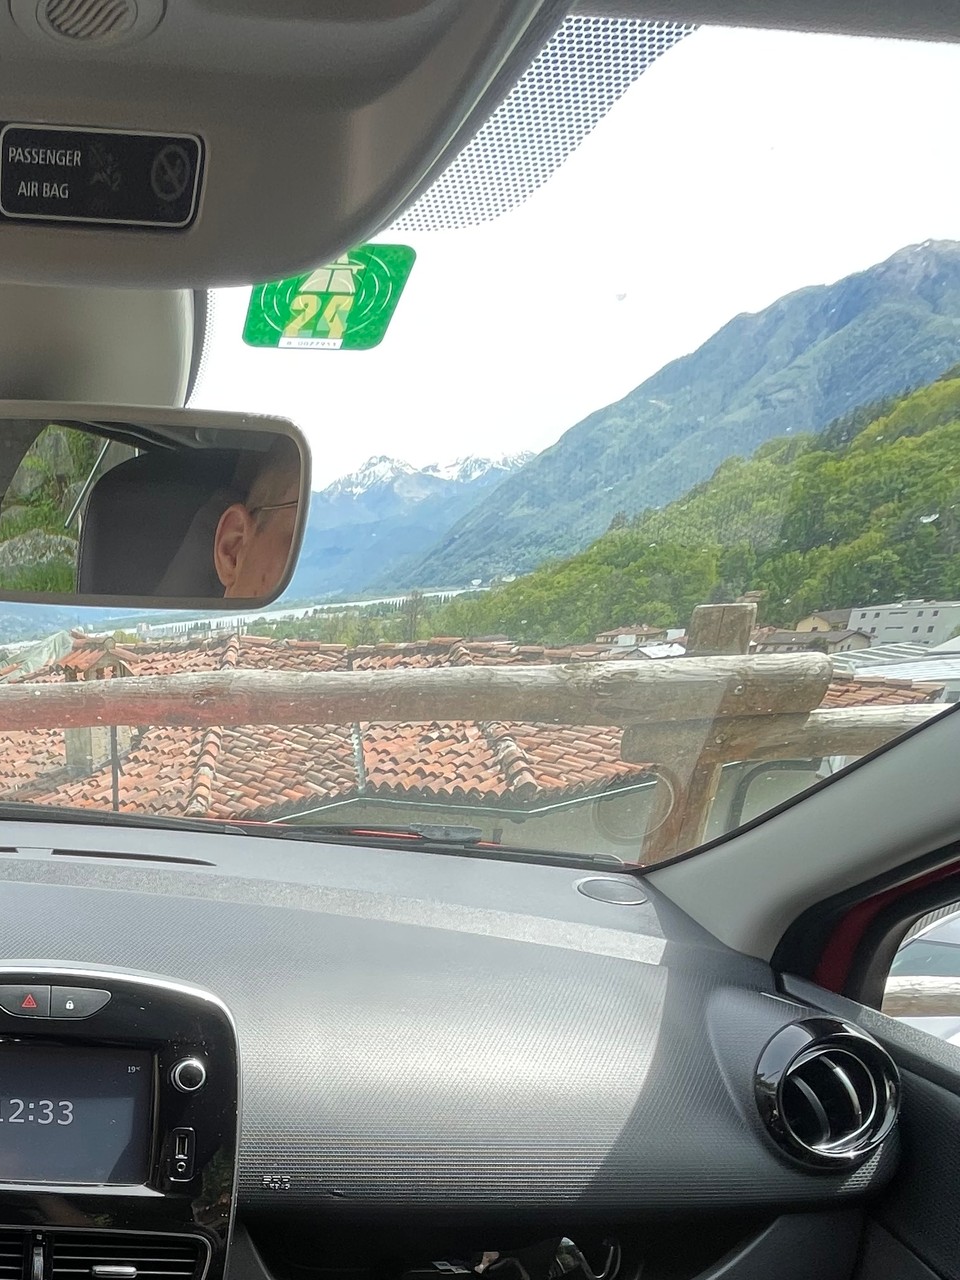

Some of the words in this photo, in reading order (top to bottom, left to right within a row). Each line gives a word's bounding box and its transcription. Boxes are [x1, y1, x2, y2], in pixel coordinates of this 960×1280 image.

[8, 146, 81, 167] PASSENGER
[17, 181, 38, 198] AIR
[42, 182, 69, 199] BAG
